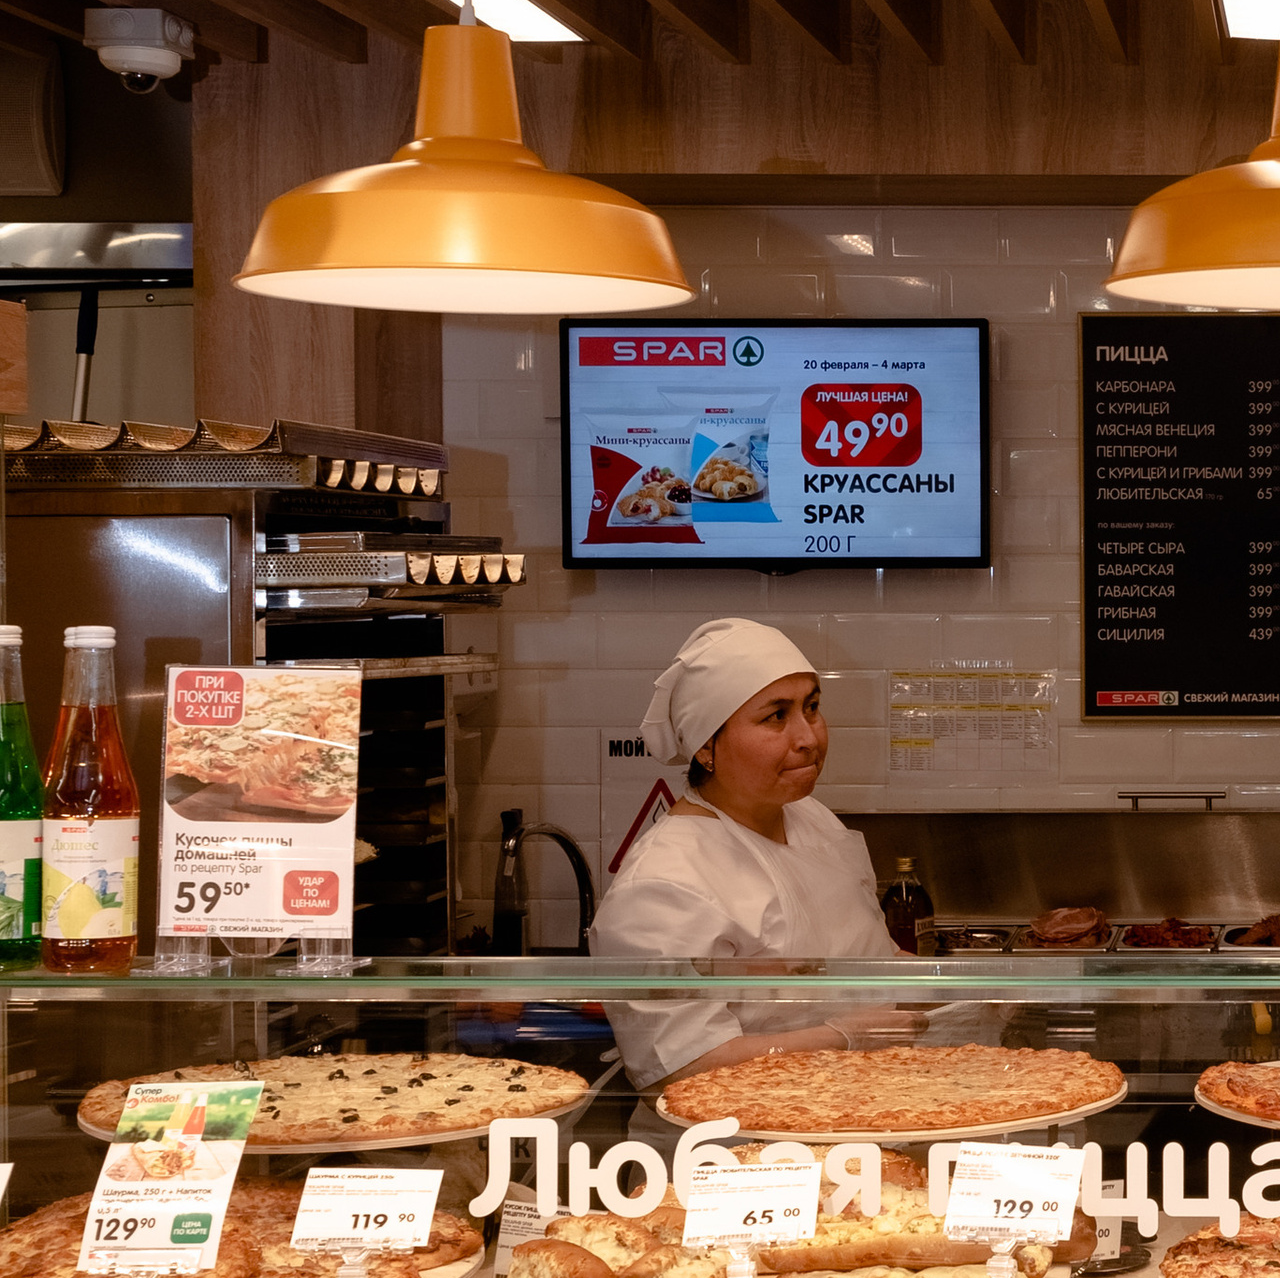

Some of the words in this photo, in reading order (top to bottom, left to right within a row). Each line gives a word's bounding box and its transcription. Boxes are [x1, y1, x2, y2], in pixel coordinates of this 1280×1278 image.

[613, 341, 724, 361] SPAR
[1096, 346, 1168, 365] ПИЦЦА
[803, 360, 817, 370] 20
[820, 359, 869, 372] февраля
[881, 360, 888, 370] 4
[891, 361, 926, 372] марта
[1096, 381, 1176, 392] КАРБОНАРА
[1249, 381, 1272, 392] 399
[816, 391, 868, 402] ЛУЧШАЯ
[872, 391, 908, 404] ЦЕНА!
[1096, 403, 1105, 414] С
[1109, 401, 1169, 416] КУРИЦЕЙ
[1249, 403, 1272, 414] 399
[1096, 424, 1151, 436] МЯСНАЯ
[1156, 424, 1215, 438] ВЕНЕЦИЯ
[1249, 424, 1272, 436] 399
[596, 435, 690, 447] Мини-круассаны
[1096, 446, 1177, 457] ПЕППЕРОНИ
[1249, 446, 1272, 457] 399
[1096, 467, 1105, 479] С
[1109, 465, 1167, 481] КУРИЦЕЙ
[1170, 467, 1179, 479] И
[1183, 467, 1242, 479] ГРИБАМИ
[1249, 467, 1272, 479] 399
[804, 474, 954, 494] КРУАССАНЫ
[1096, 488, 1203, 500] ЛЮБИТЕЛЬСКАЯ
[1257, 488, 1272, 500] 65
[804, 505, 865, 524] SPAR
[805, 536, 843, 553] 200
[847, 536, 855, 553] Г
[1098, 542, 1144, 554] ЧЕТЫРЕ
[1148, 542, 1185, 554] СЫРА
[1249, 542, 1272, 554] 399
[1098, 564, 1174, 575] БАВАРСКАЯ
[1249, 564, 1272, 575] 399
[1098, 584, 1175, 597] ГАВАЙСКАЯ
[1249, 585, 1272, 597] 399
[1098, 607, 1156, 618] ГРИБНАЯ
[1249, 607, 1272, 618] 399
[1098, 629, 1164, 643] СИЦИЛИЯ
[1249, 629, 1272, 640] 439
[195, 676, 224, 689] ПРИ
[177, 690, 240, 705] ПОКУПКЕ
[1112, 694, 1159, 703] SPAR
[1184, 692, 1228, 702] СВЕЖИЙ
[1231, 694, 1280, 702] МАГАЗИН
[186, 705, 209, 718] 2-Х
[212, 706, 235, 719] ШТ
[191, 864, 236, 875] рецепту
[239, 863, 262, 874] Spar
[299, 877, 324, 886] УДАР
[303, 889, 319, 897] ПО
[291, 900, 330, 909] ЦЕНАМ!
[141, 1095, 179, 1103] Комбо!
[1042, 1201, 1058, 1212] 00
[351, 1214, 388, 1230] 119
[399, 1213, 415, 1223] 90
[742, 1209, 774, 1226] 65
[784, 1207, 800, 1218] 00
